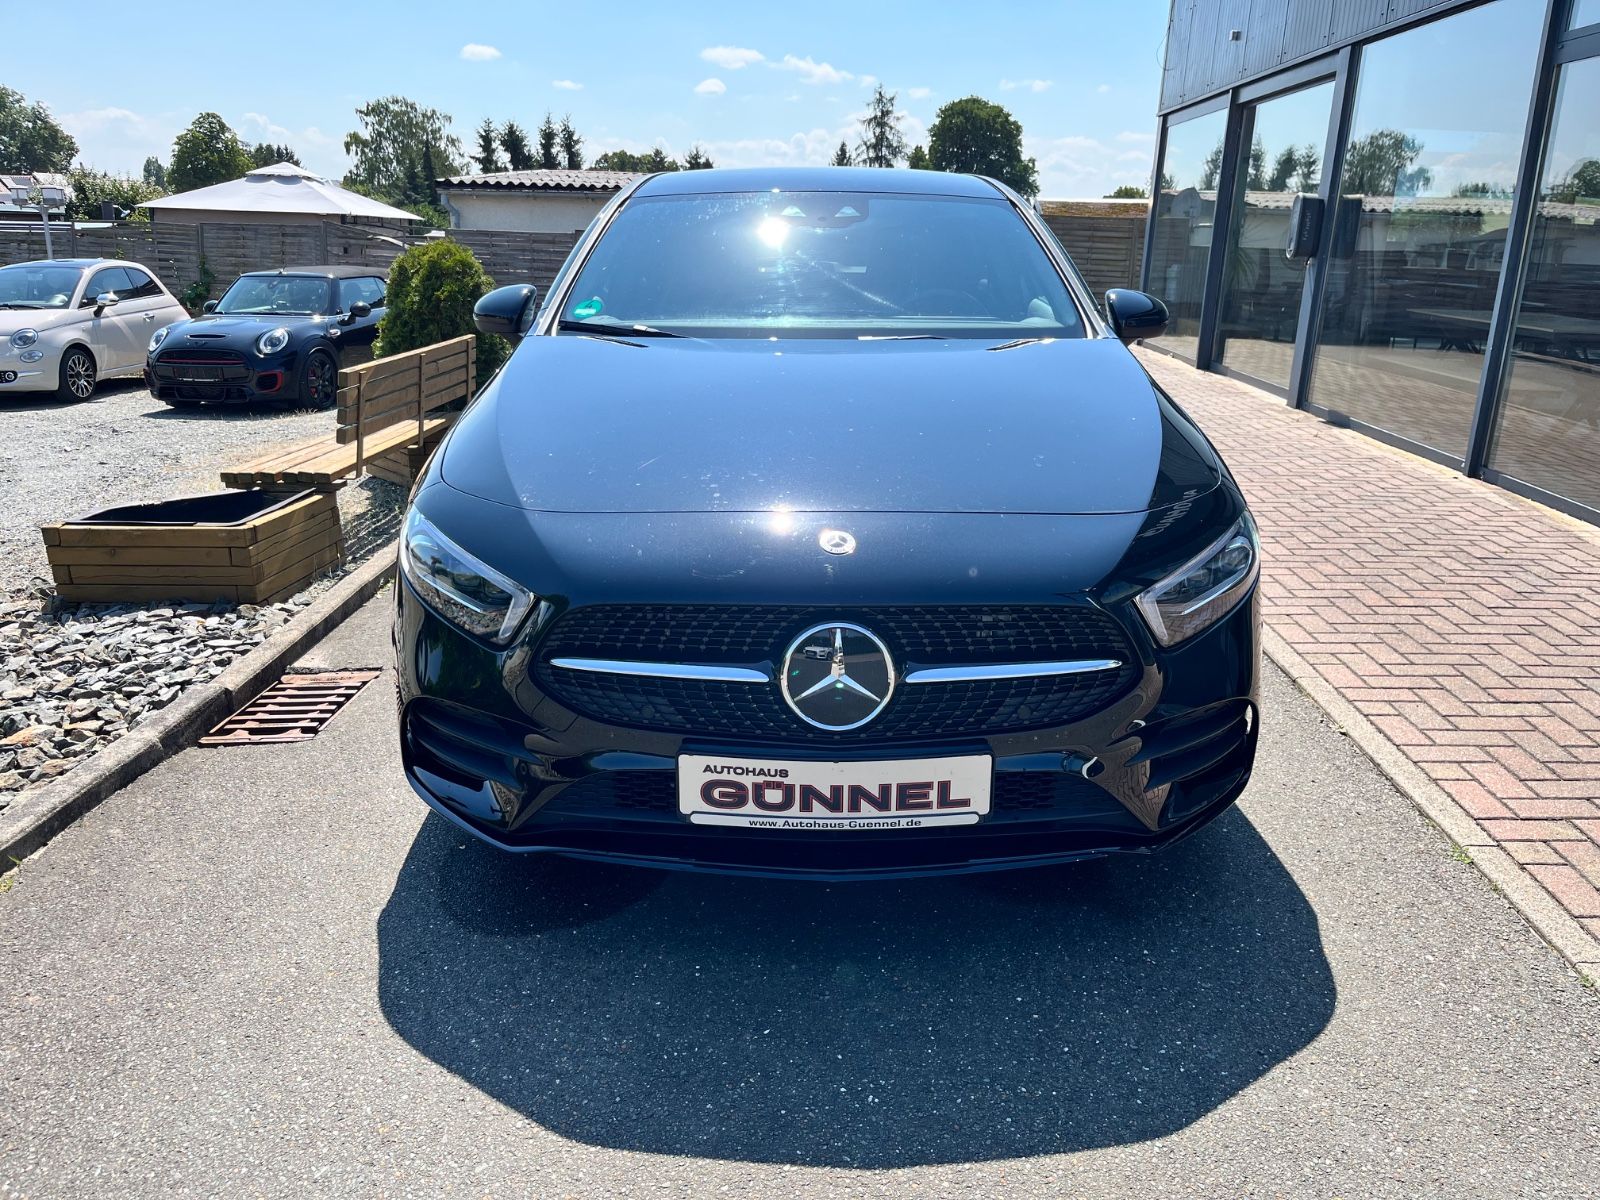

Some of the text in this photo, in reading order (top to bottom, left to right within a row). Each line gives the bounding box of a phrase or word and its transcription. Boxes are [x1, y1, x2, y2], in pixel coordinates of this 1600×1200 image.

[703, 764, 789, 778] AUTOHAUS
[700, 779, 971, 813] GÜNNEL
[748, 818, 922, 829] www.Autohaus-Guennel.de
